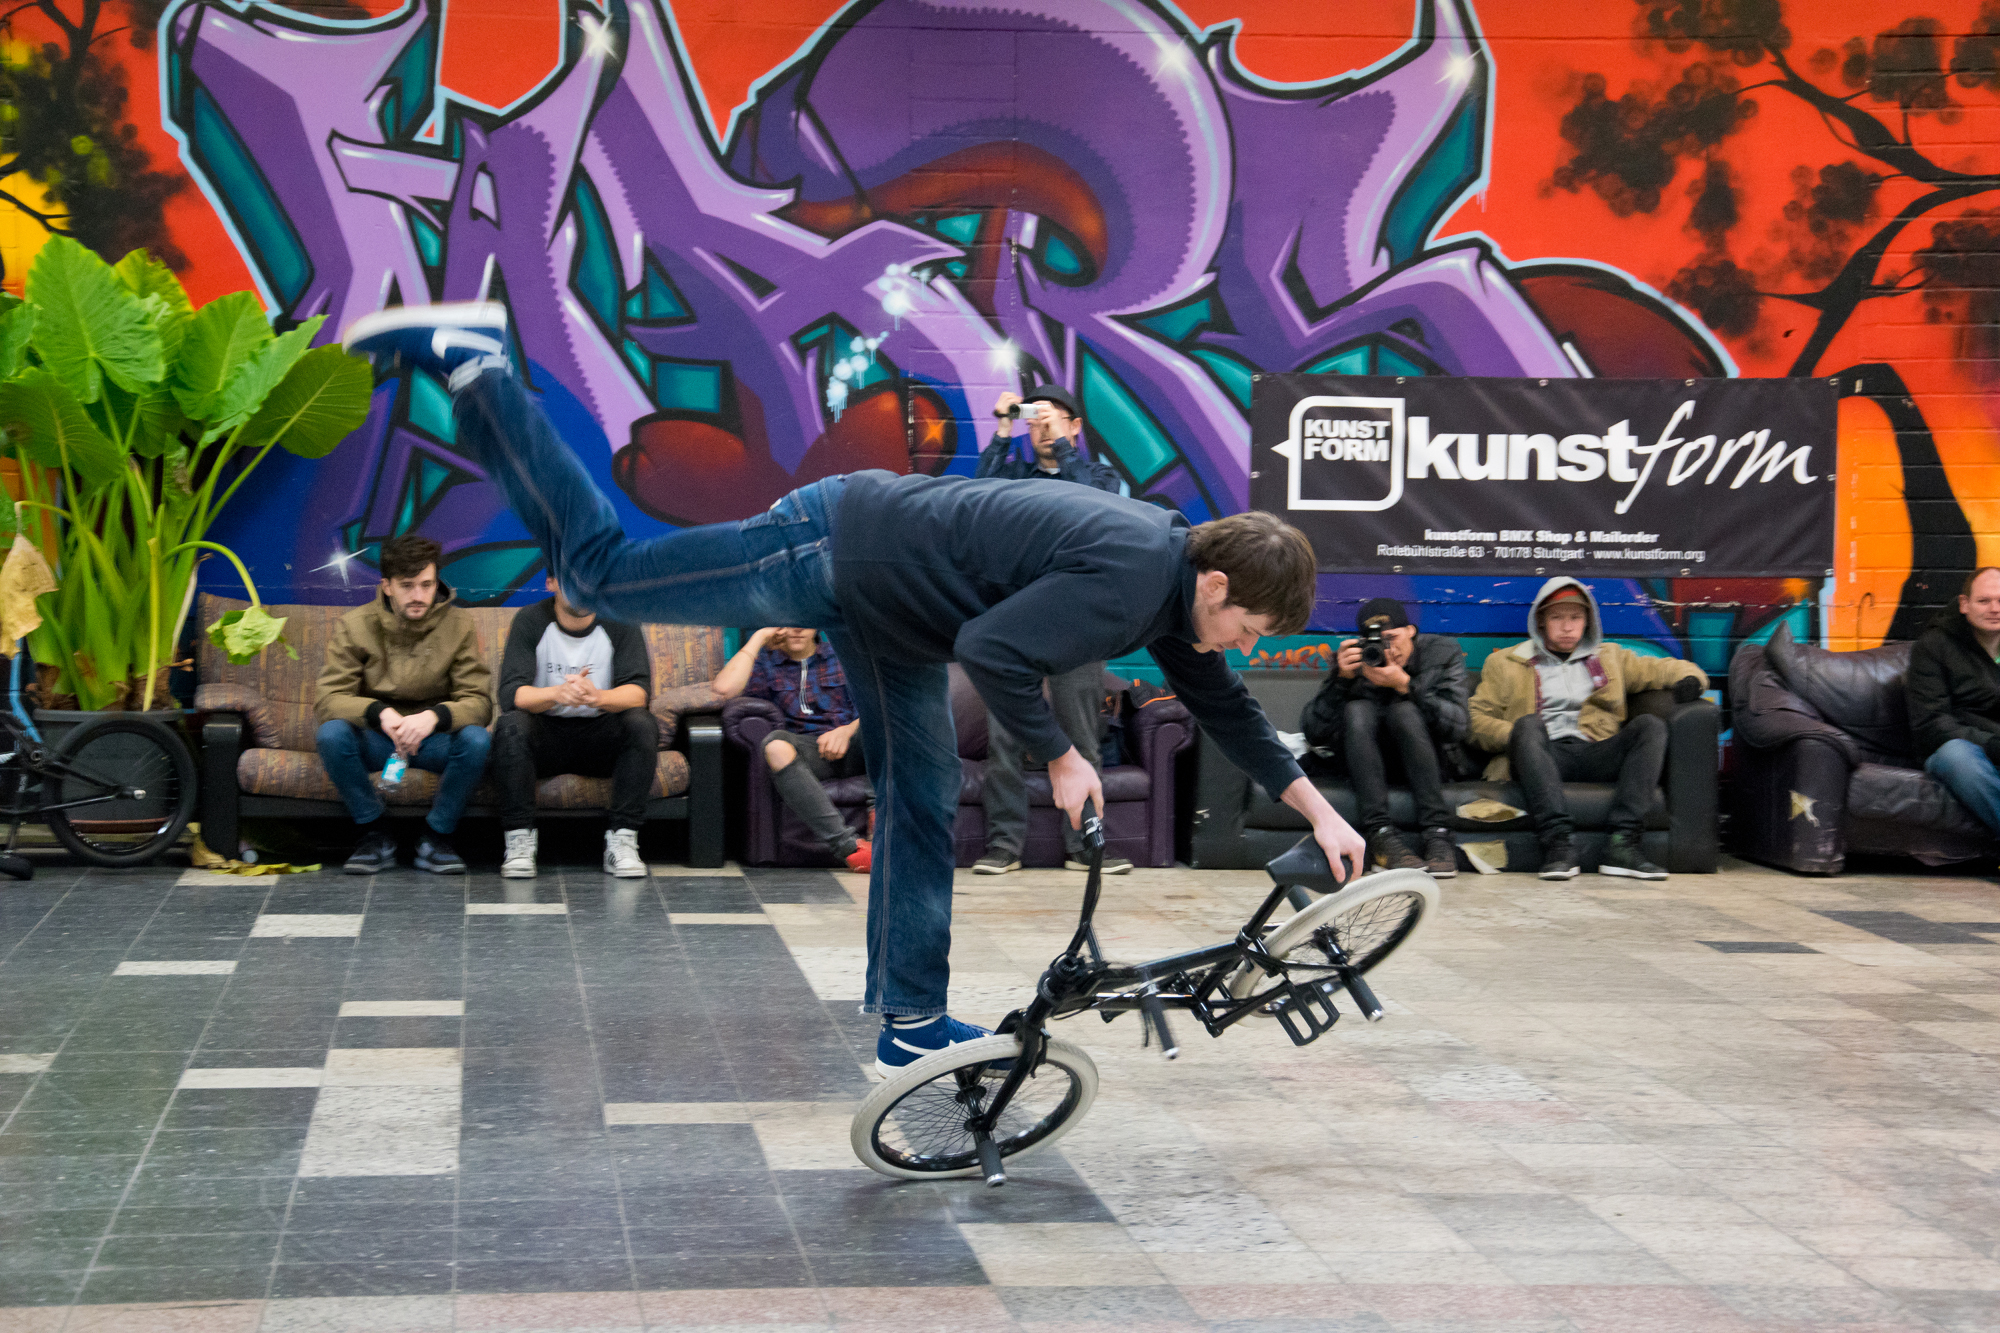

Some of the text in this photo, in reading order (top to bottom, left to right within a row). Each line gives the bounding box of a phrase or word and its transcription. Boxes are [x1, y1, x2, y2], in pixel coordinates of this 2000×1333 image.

[1304, 419, 1391, 438] KUNST
[1304, 438, 1390, 461] FORM
[1424, 529, 1660, 544] kunstform BMX Shop & Mailorder
[1467, 546, 1485, 558] 63
[1494, 546, 1532, 558] 70178
[1533, 547, 1585, 561] Stuttgart
[1593, 548, 1706, 562] www.kunstform.org
